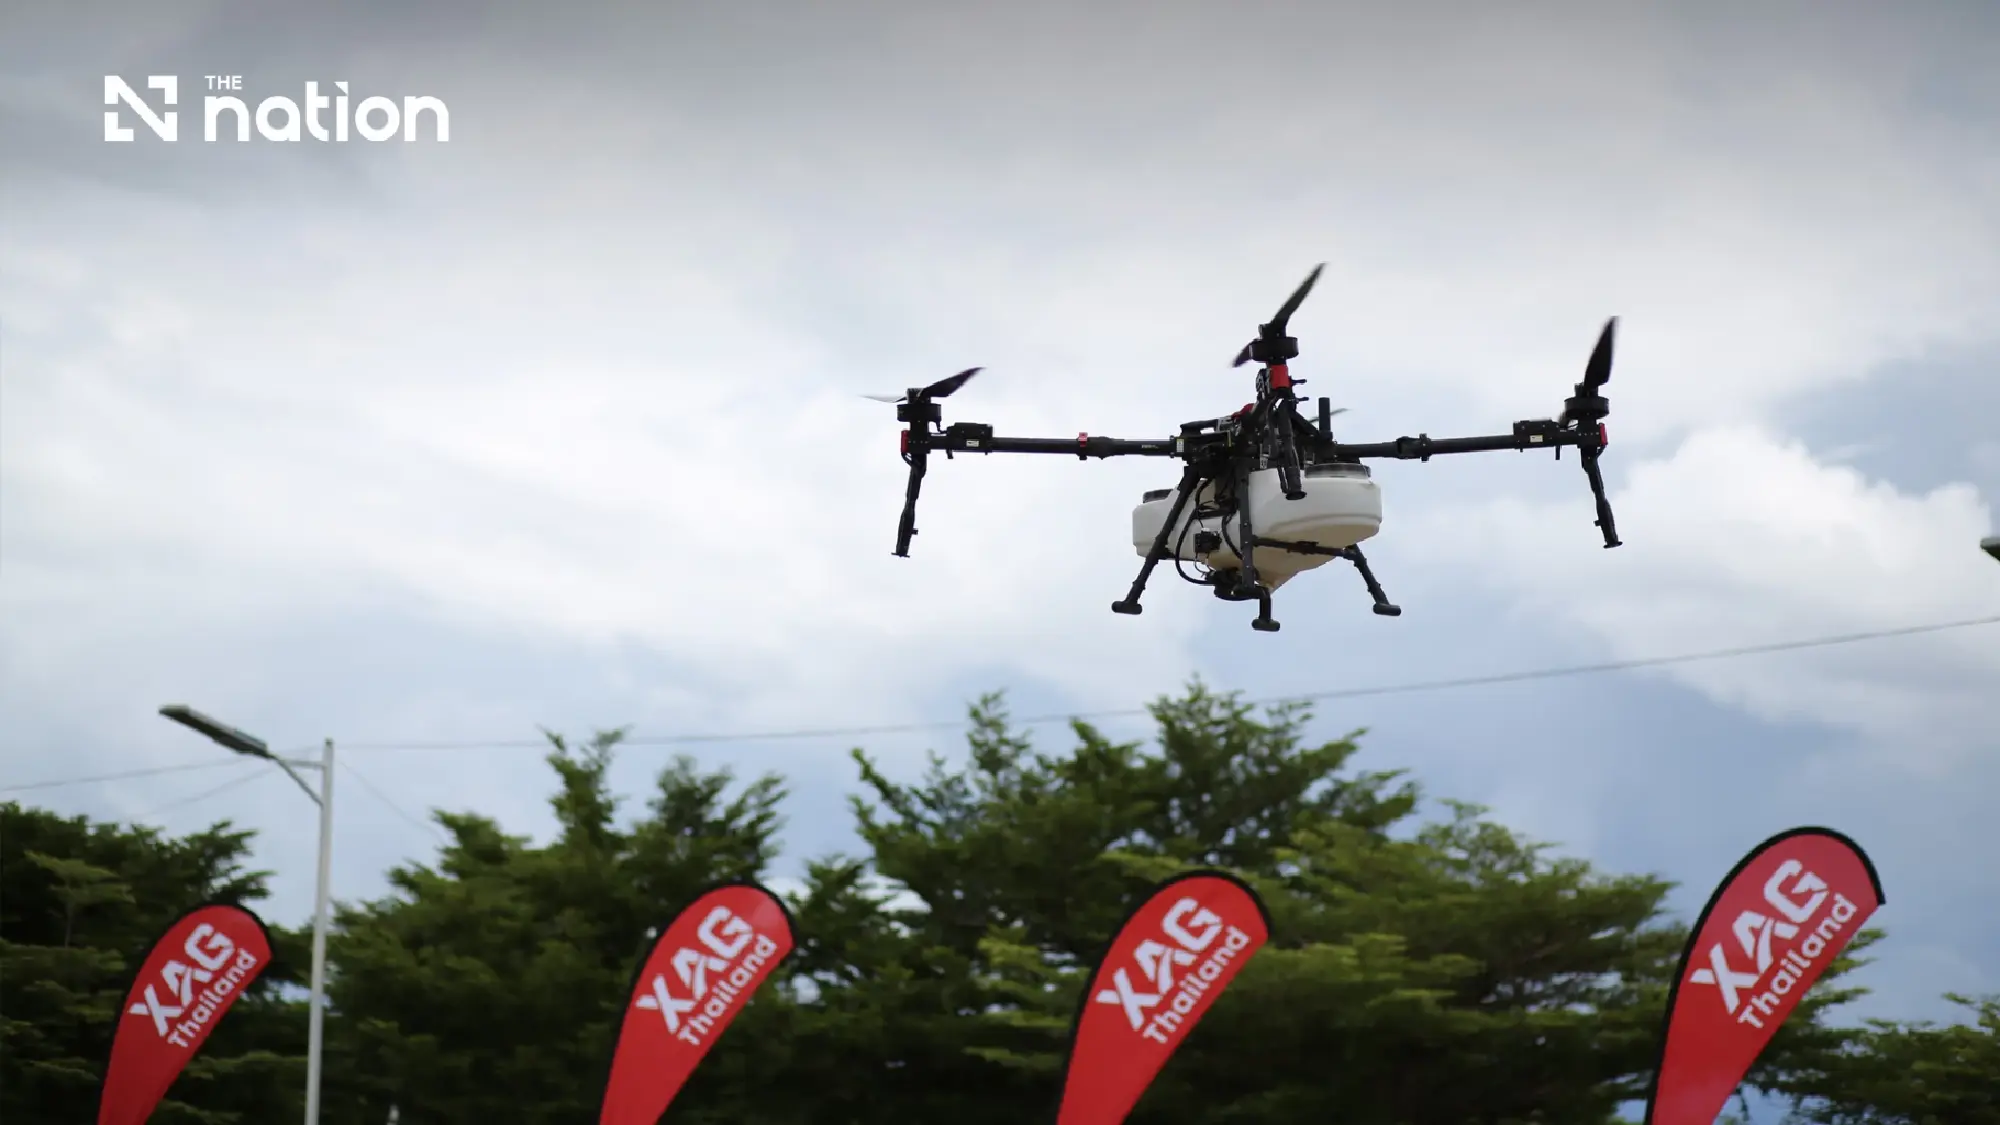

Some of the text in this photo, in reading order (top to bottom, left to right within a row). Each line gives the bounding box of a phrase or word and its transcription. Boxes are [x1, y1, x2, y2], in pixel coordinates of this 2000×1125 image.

[128, 923, 235, 1037] XAG
[167, 948, 258, 1048] Thailand
[636, 905, 753, 1034] XAG
[677, 933, 778, 1046] Thailand
[1096, 896, 1223, 1032] XAG
[1143, 925, 1251, 1045] Thailand
[1689, 859, 1829, 1016] XAG
[1737, 892, 1858, 1029] Thailand
